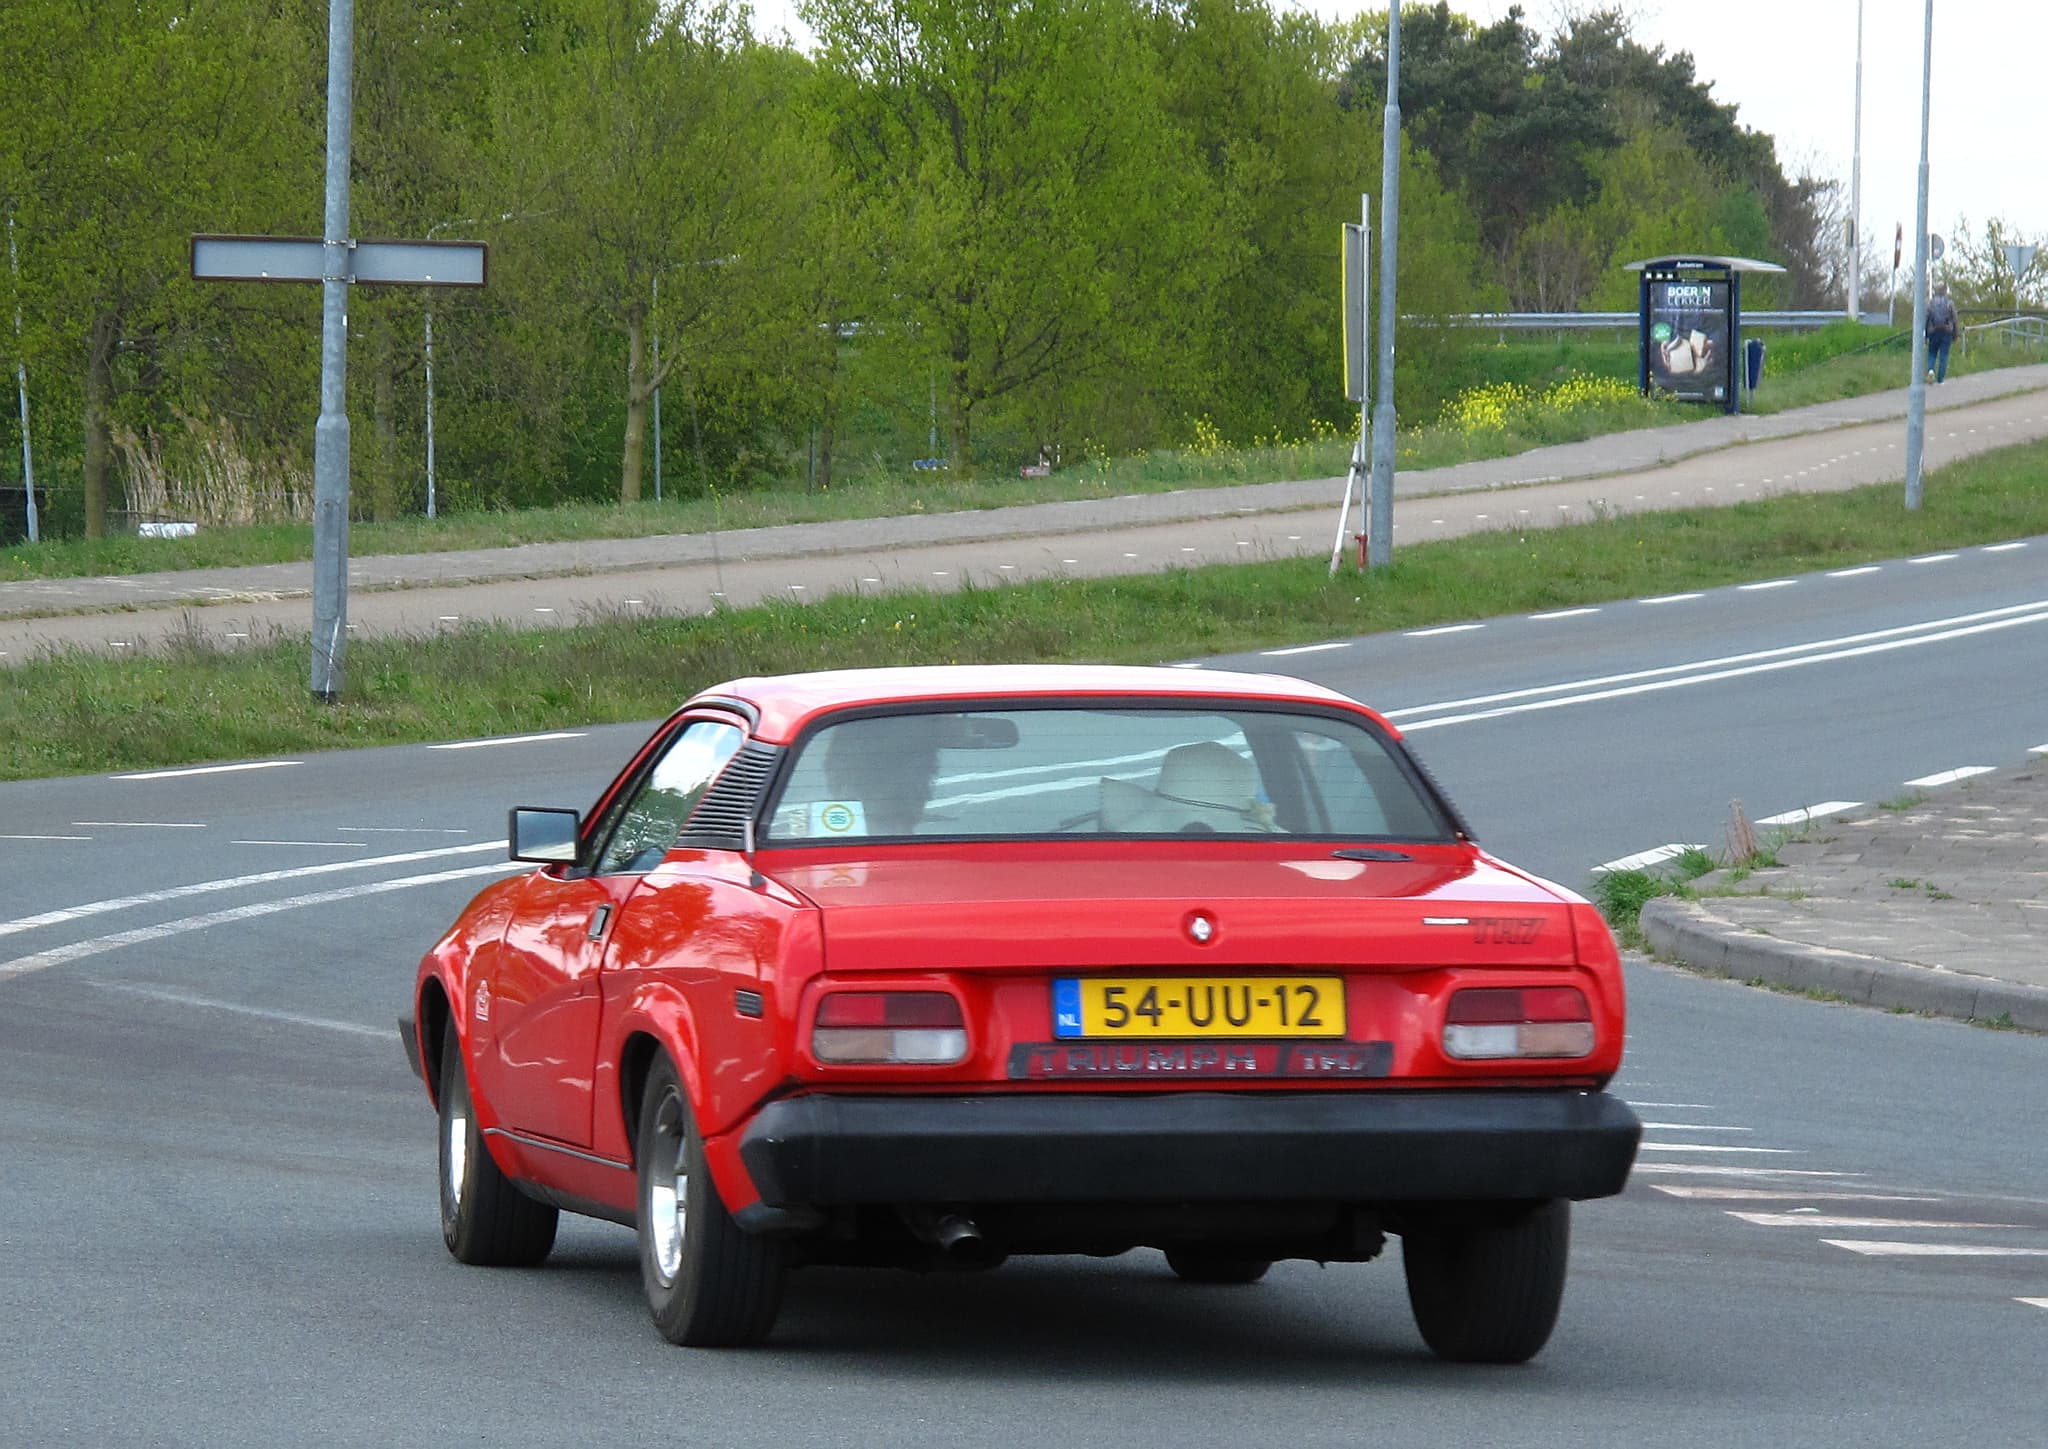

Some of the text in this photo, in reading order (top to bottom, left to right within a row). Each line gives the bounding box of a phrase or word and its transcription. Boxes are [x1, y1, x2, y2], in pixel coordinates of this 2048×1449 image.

[1104, 985, 1323, 1027] 54-UU-12
[1058, 1014, 1080, 1026] NL
[1032, 1048, 1257, 1071] TRIUMPH
